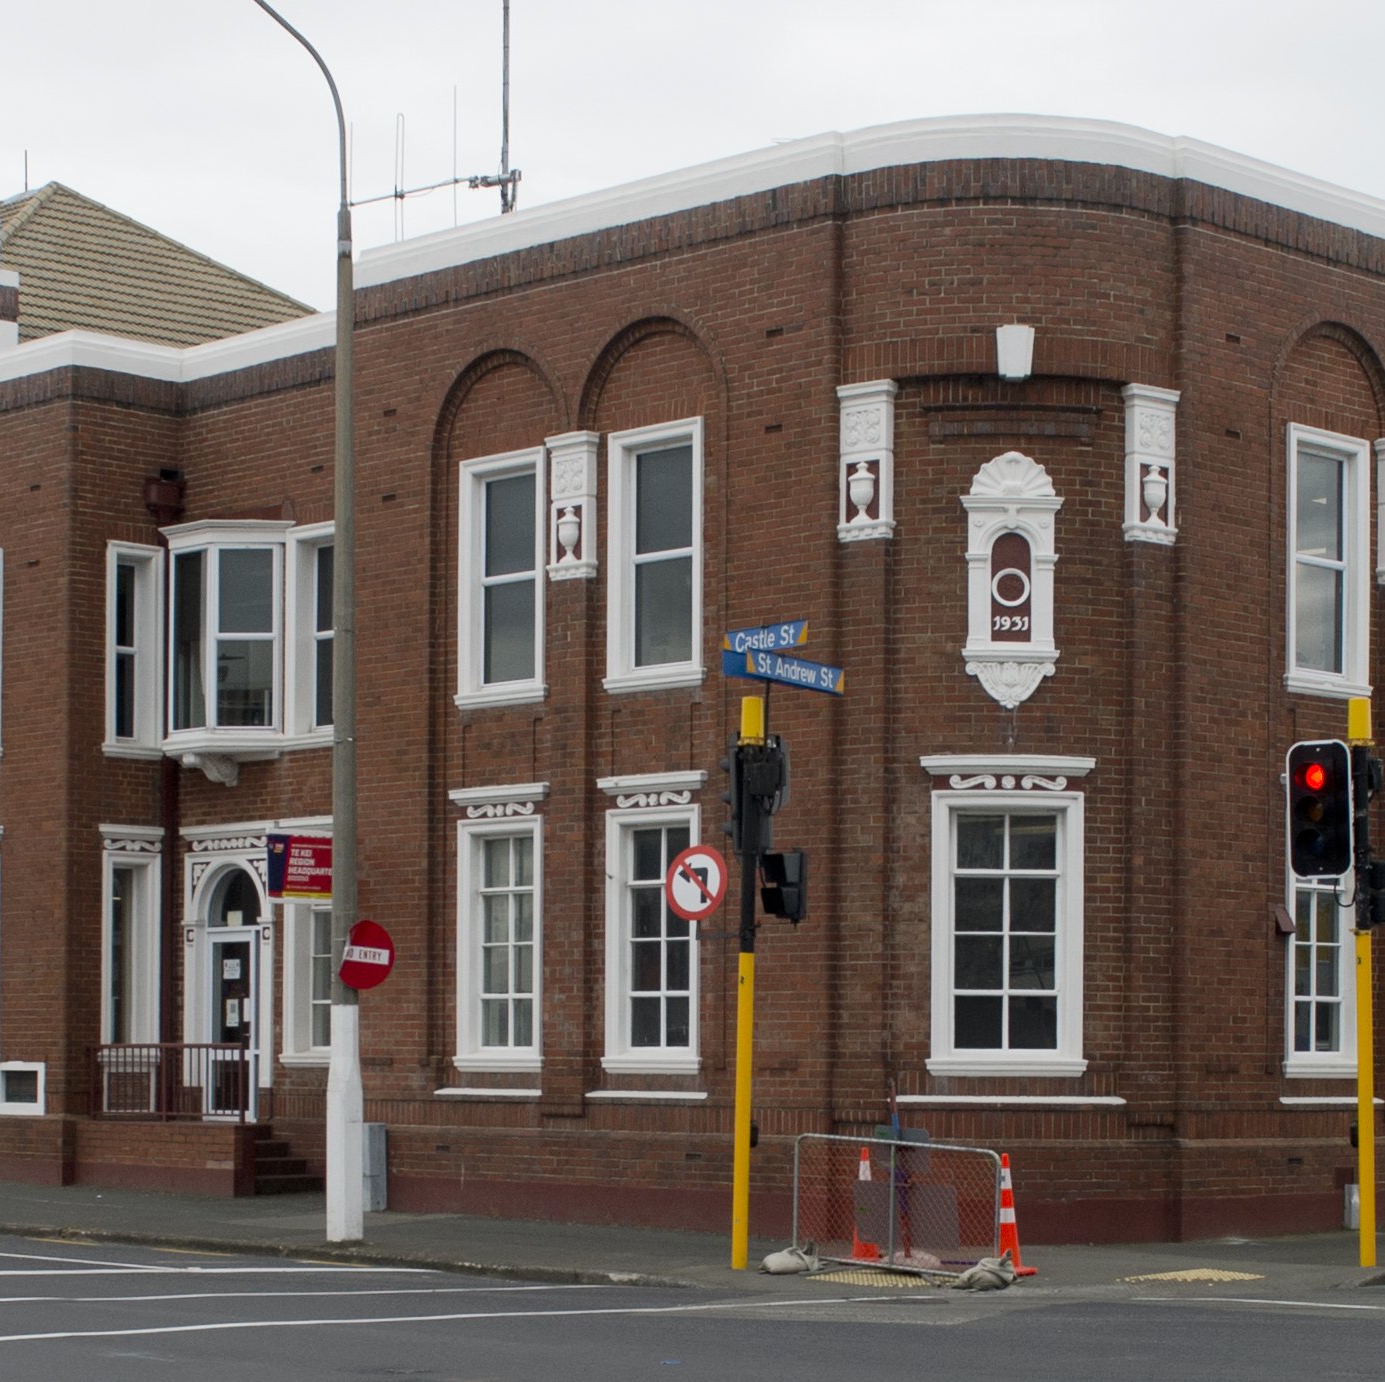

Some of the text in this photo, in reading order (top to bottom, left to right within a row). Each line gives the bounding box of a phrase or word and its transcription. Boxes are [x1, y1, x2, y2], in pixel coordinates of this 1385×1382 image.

[993, 616, 1029, 631] 1931
[735, 625, 795, 653] Castle St
[758, 653, 833, 688] St Andrew St
[358, 949, 383, 961] ENTRY
